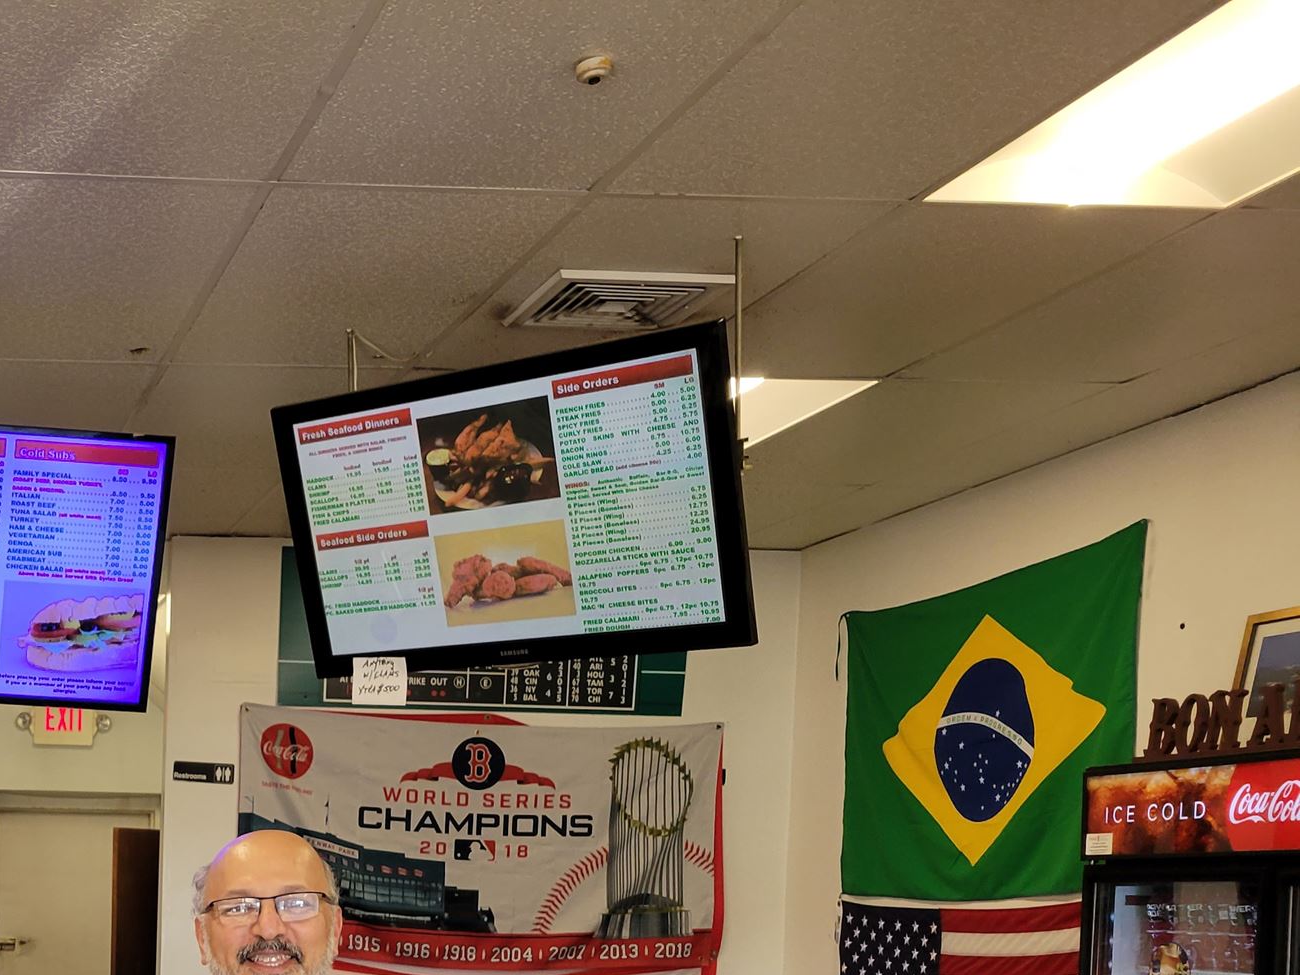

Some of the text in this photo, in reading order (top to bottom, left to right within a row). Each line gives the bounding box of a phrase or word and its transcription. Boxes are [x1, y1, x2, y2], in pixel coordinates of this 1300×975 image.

[556, 376, 620, 394] Side Orders
[555, 406, 584, 416] FRENCH
[584, 401, 606, 410] FRIES
[302, 417, 400, 440] Fresh Seafood Dinners
[20, 448, 76, 460] Cold Subs
[13, 469, 73, 479] FAMILY SPECIAL
[320, 530, 408, 548] Seafood Side Orders
[574, 549, 607, 558] POPCORN
[608, 546, 640, 554] CHICKEN
[575, 547, 696, 566] MOZZARELLA STICKS WITH SAUCE
[589, 662, 603, 670] ARI
[430, 678, 448, 686] OUT
[587, 679, 604, 687] TAM
[1147, 689, 1249, 756] BON
[263, 740, 310, 762] Coca-Cola
[464, 743, 492, 783] B
[174, 772, 207, 781] Restrooms
[383, 786, 572, 809] WORLD SERIES
[1104, 779, 1300, 826] ICE COLD Coca-Col
[358, 806, 594, 838] CHAMPIONS
[348, 934, 692, 963] 1915 1916 1918 2004 2007 2013 2018
